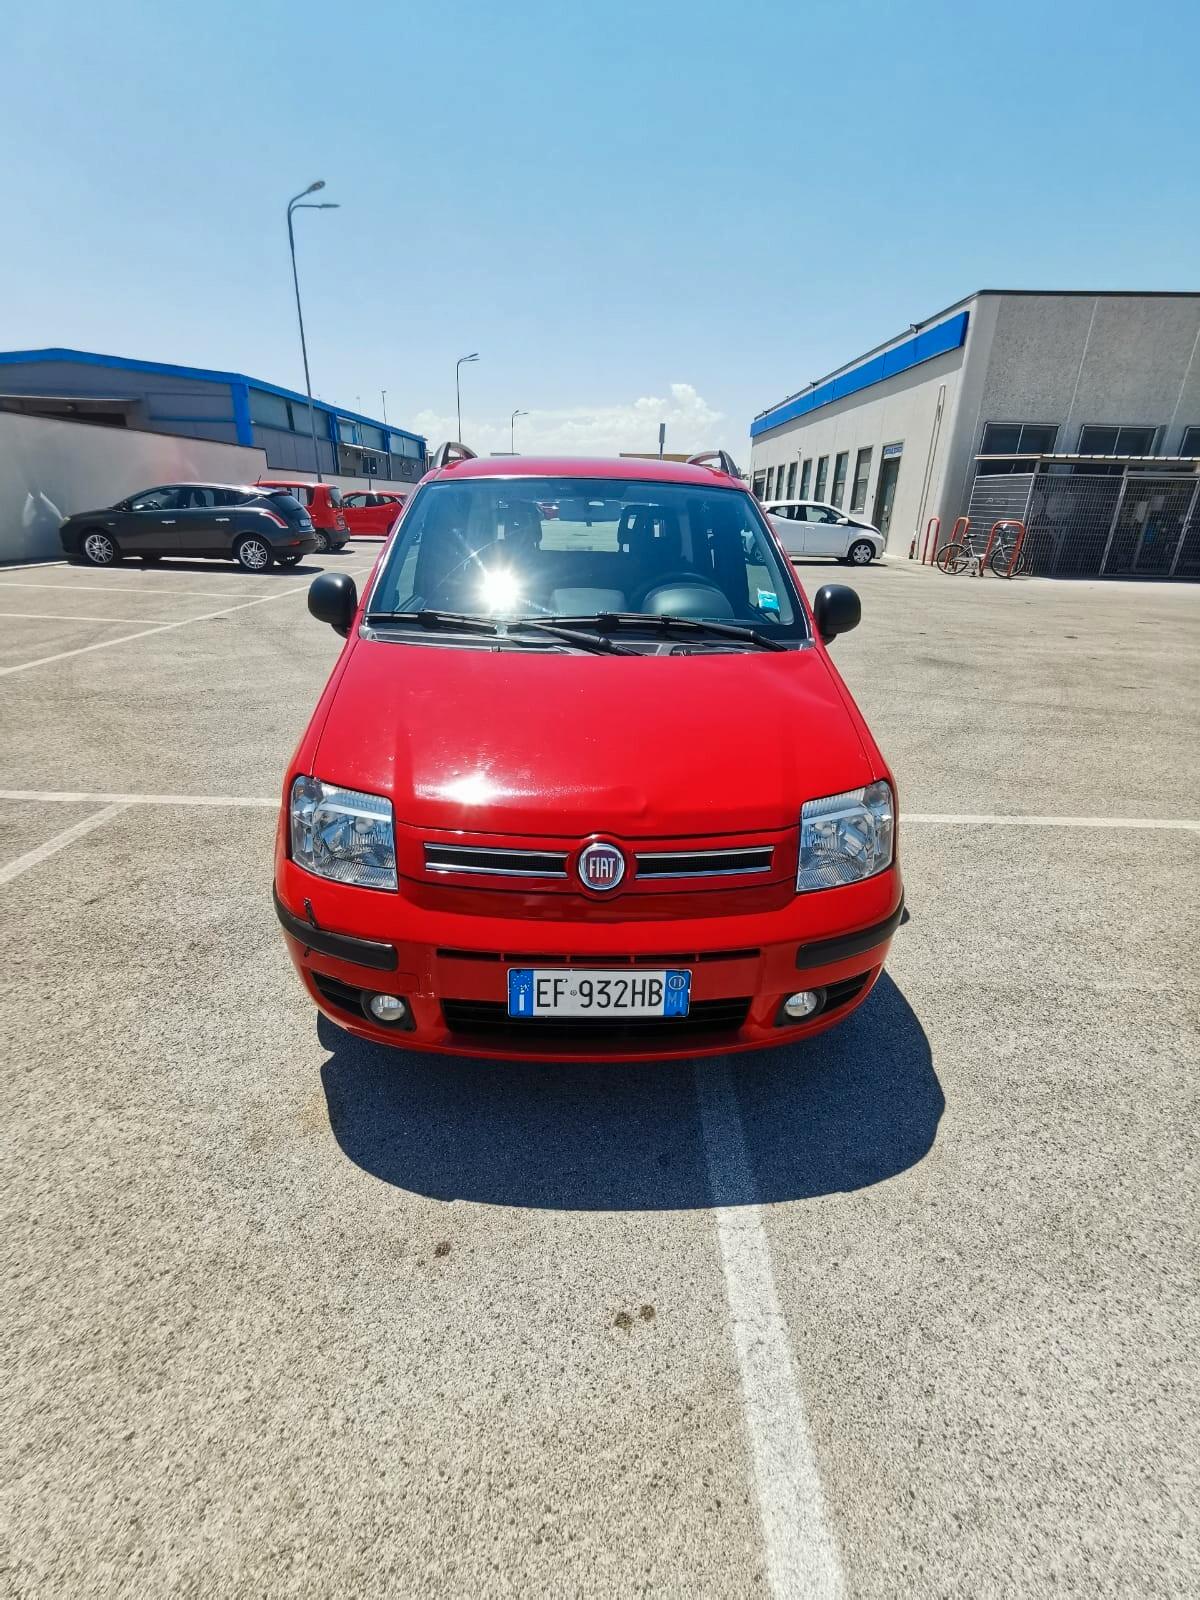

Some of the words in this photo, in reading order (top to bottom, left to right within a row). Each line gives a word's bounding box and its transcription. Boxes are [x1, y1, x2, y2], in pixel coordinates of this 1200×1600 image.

[589, 857, 616, 878] FIAT
[536, 979, 568, 1008] EF
[578, 979, 664, 1008] 932HB
